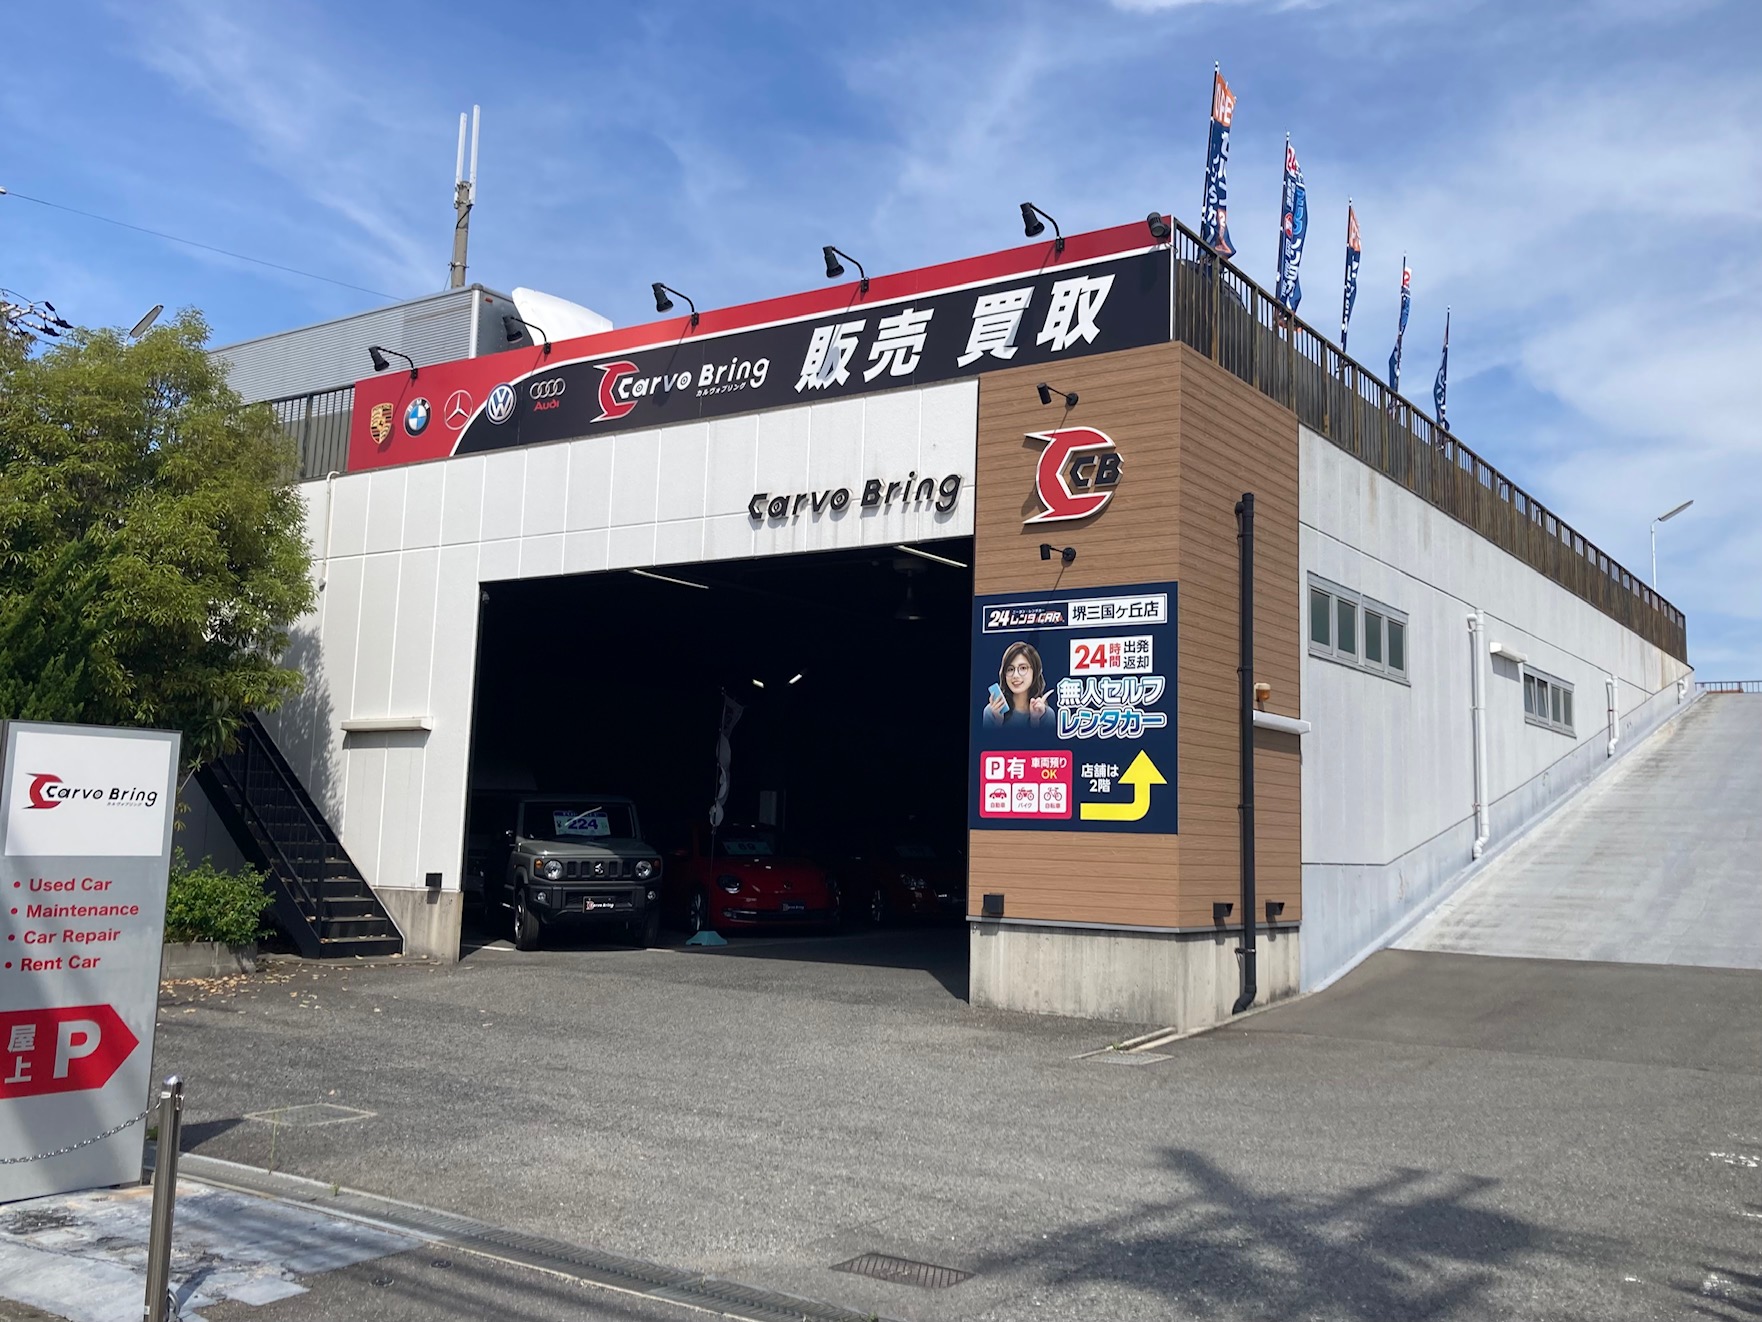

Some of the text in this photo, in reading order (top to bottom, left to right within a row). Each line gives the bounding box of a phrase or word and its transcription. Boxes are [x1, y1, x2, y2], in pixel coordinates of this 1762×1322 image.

[794, 273, 1116, 394] 販売 買取
[617, 356, 770, 400] Carvo Bring
[533, 399, 560, 412] Audi
[1069, 452, 1124, 490] CB
[748, 470, 963, 521] Carvo Bring
[1109, 643, 1121, 668] 時間
[1123, 639, 1149, 654] 出発
[1074, 644, 1108, 670] 24
[1123, 655, 1150, 670] 返却
[1058, 677, 1165, 706] 無人セルフ
[1059, 707, 1166, 738] レンタカー
[1031, 757, 1067, 769] 車両預り
[1081, 762, 1119, 778] 店舗は
[1041, 769, 1058, 780] OK
[1089, 778, 1111, 793] 2階
[46, 785, 158, 808] Carvo Bring
[29, 877, 112, 892] Used Car
[26, 904, 139, 918] Maintenance
[23, 928, 121, 945] Car Repair
[20, 955, 101, 972] Rent Car
[4, 1023, 37, 1084] 屋上
[52, 1018, 102, 1080] P
